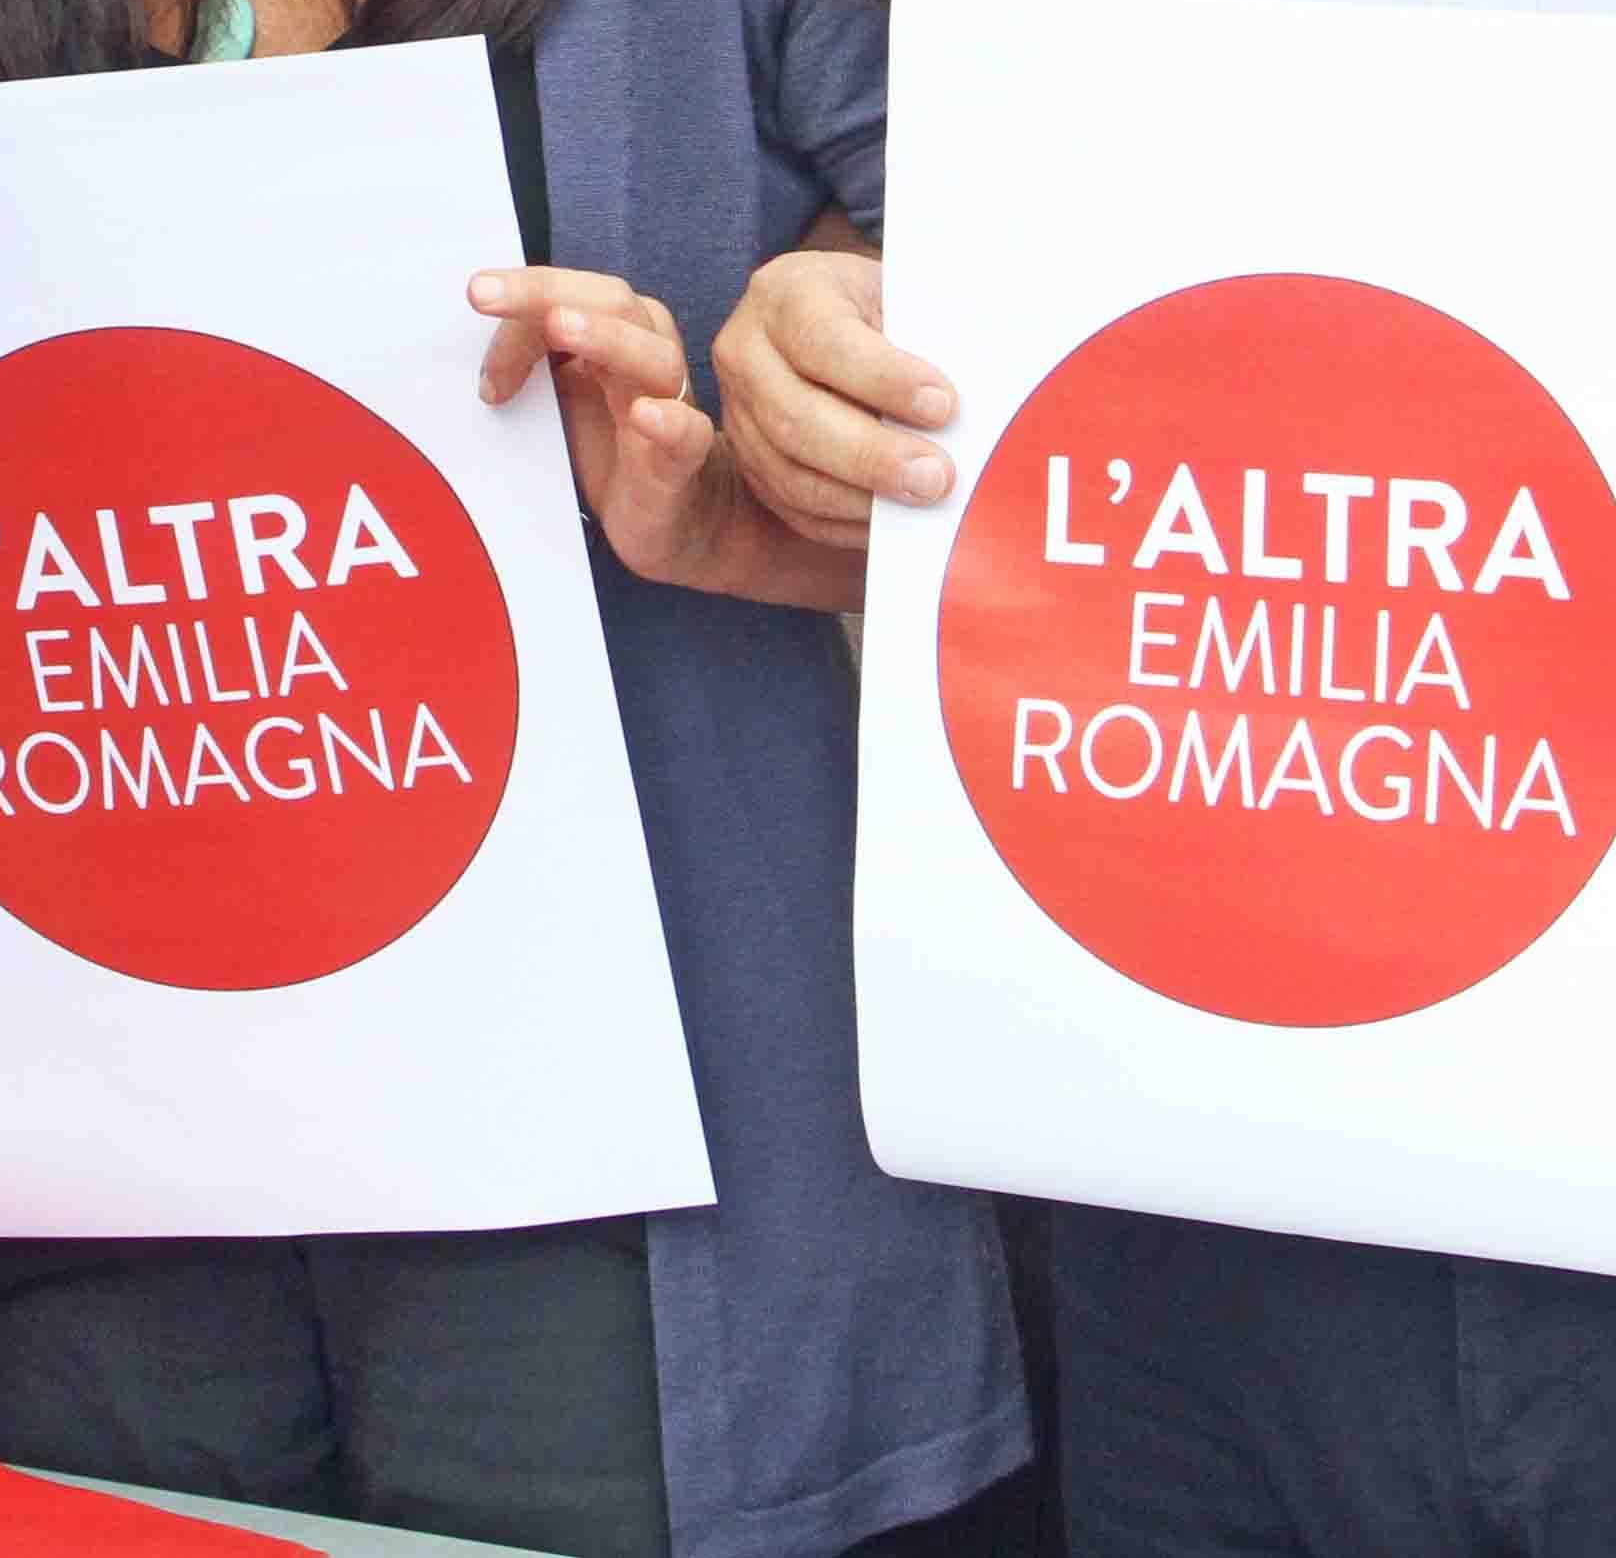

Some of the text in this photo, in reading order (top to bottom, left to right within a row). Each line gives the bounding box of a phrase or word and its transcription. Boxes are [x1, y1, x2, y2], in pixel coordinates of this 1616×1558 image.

[1045, 456, 1570, 599] L'ALTRA
[26, 611, 348, 711] EMILIA
[1129, 592, 1470, 709] EMILIA
[1013, 698, 1576, 836] ROMAGNA
